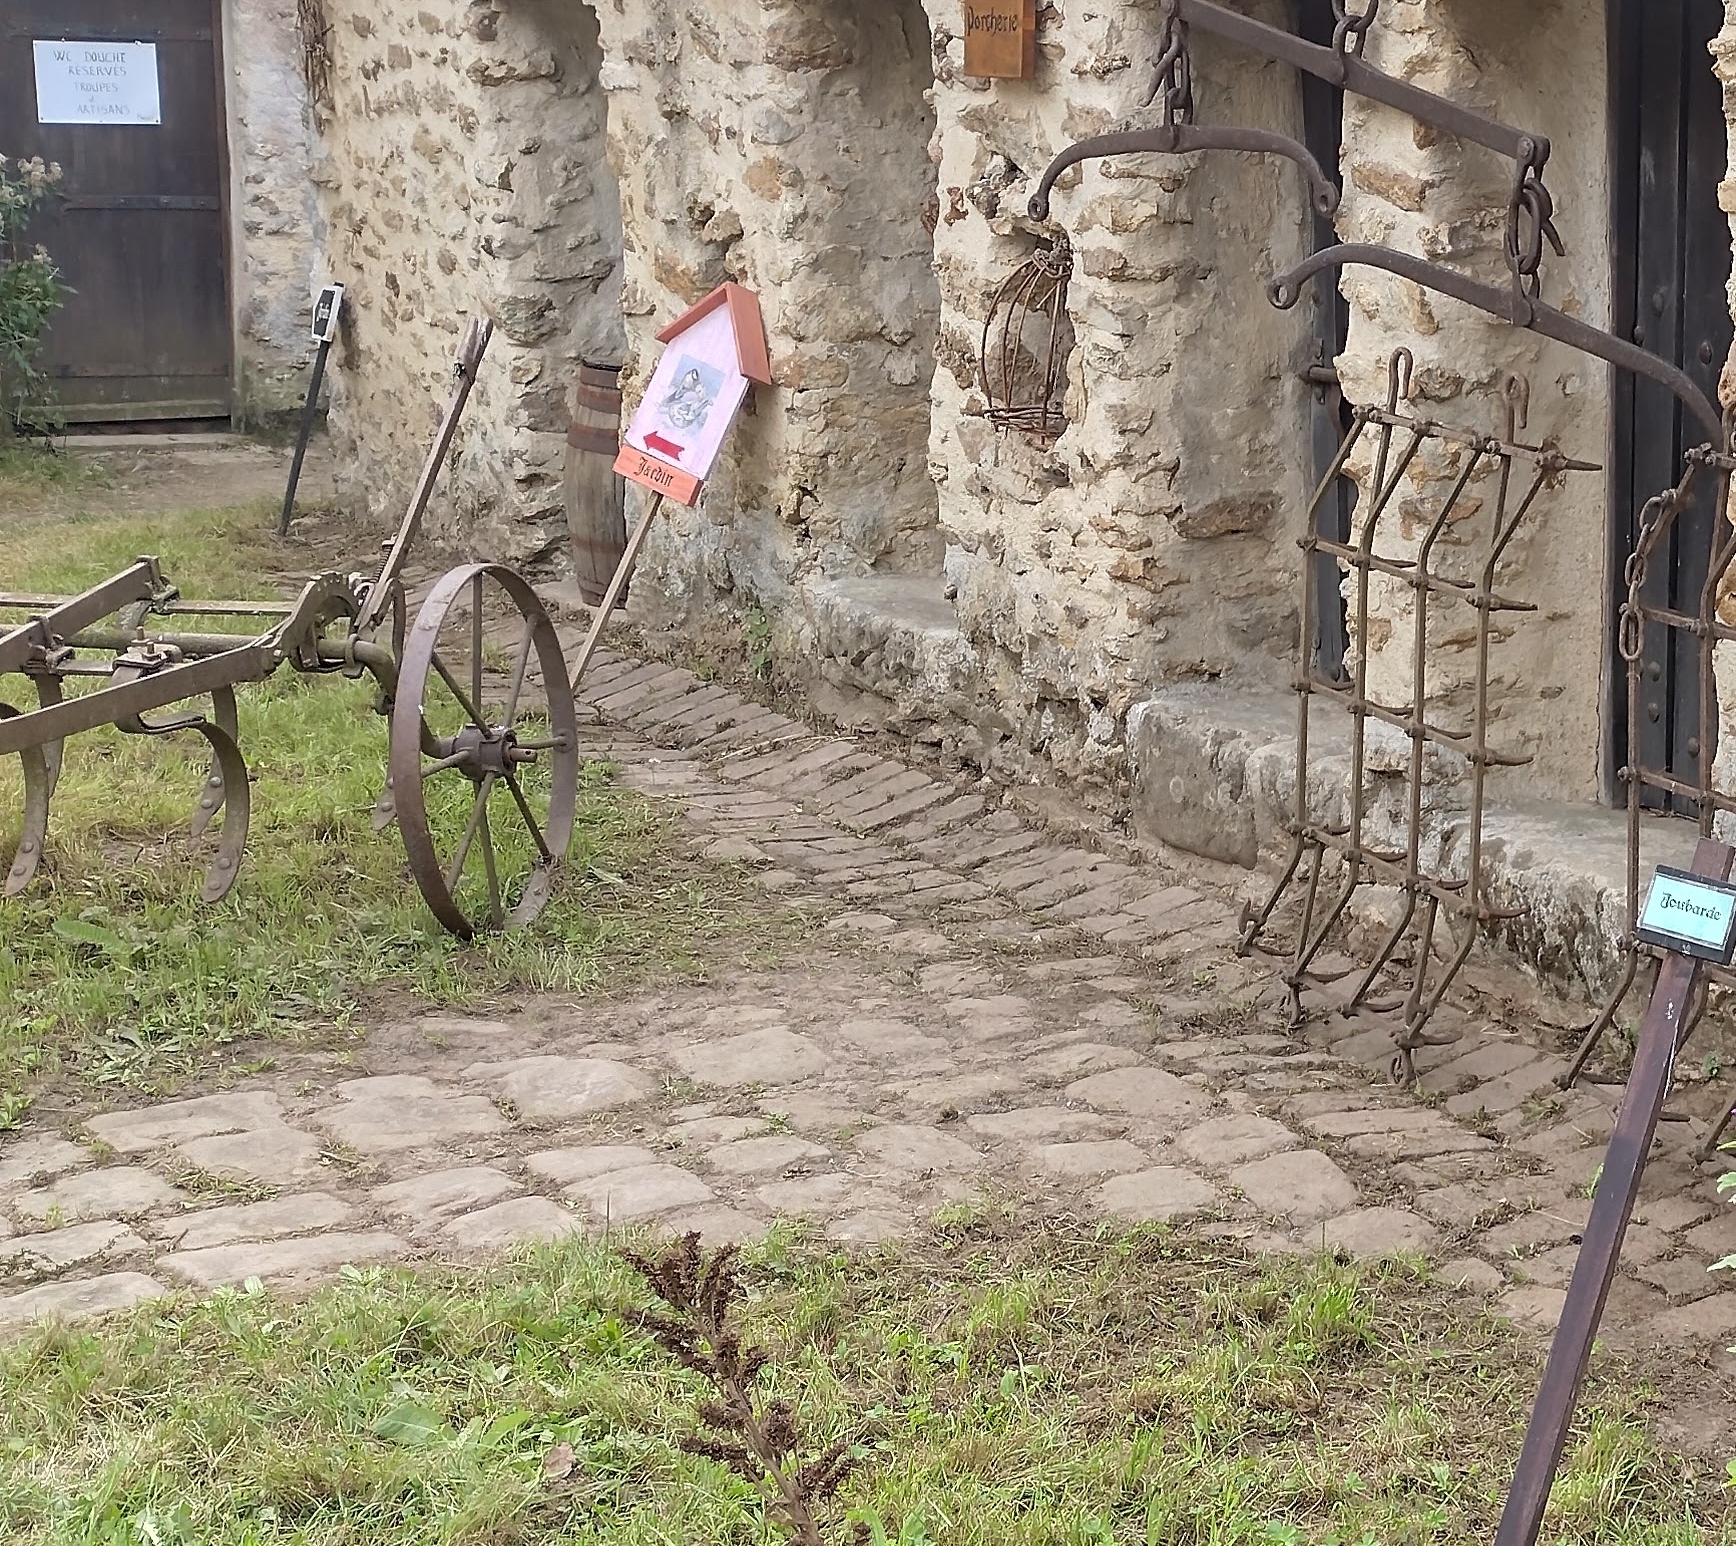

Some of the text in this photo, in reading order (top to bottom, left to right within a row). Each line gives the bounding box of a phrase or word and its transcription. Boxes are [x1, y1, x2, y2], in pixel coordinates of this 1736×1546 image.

[964, 5, 1018, 37] Porcherie
[53, 50, 127, 63] WC DOUCHE
[73, 82, 119, 93] TROUPES
[77, 104, 131, 115] ARTISANS
[633, 456, 674, 488] Jardin
[1660, 891, 1722, 921] Joubarde
